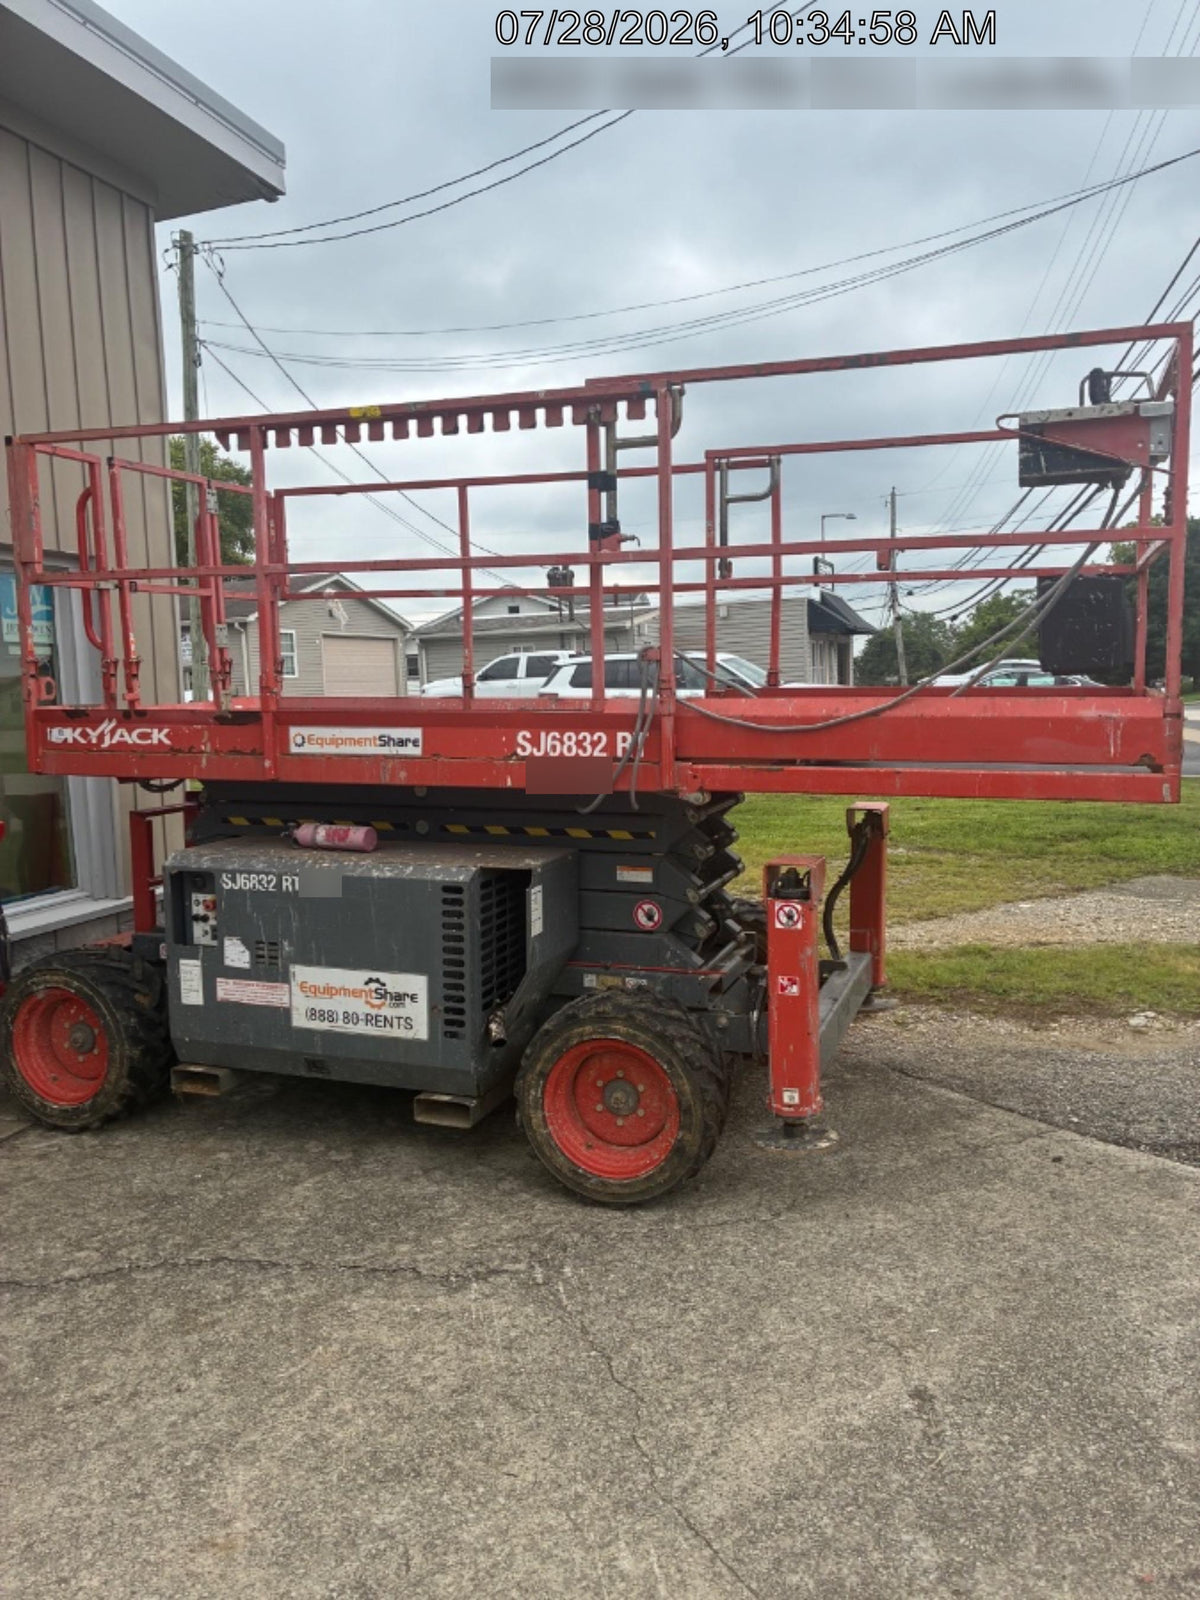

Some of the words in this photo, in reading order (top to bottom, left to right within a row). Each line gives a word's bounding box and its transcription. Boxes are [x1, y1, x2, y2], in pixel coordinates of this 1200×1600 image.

[307, 733, 420, 749] EquipmentShare
[516, 730, 607, 758] SJ6832
[221, 873, 277, 893] SJ6832
[282, 876, 299, 893] RT
[299, 980, 419, 1004] EquipmentShare
[305, 1007, 339, 1023] (888)
[342, 1011, 414, 1031] 80-RENTS
